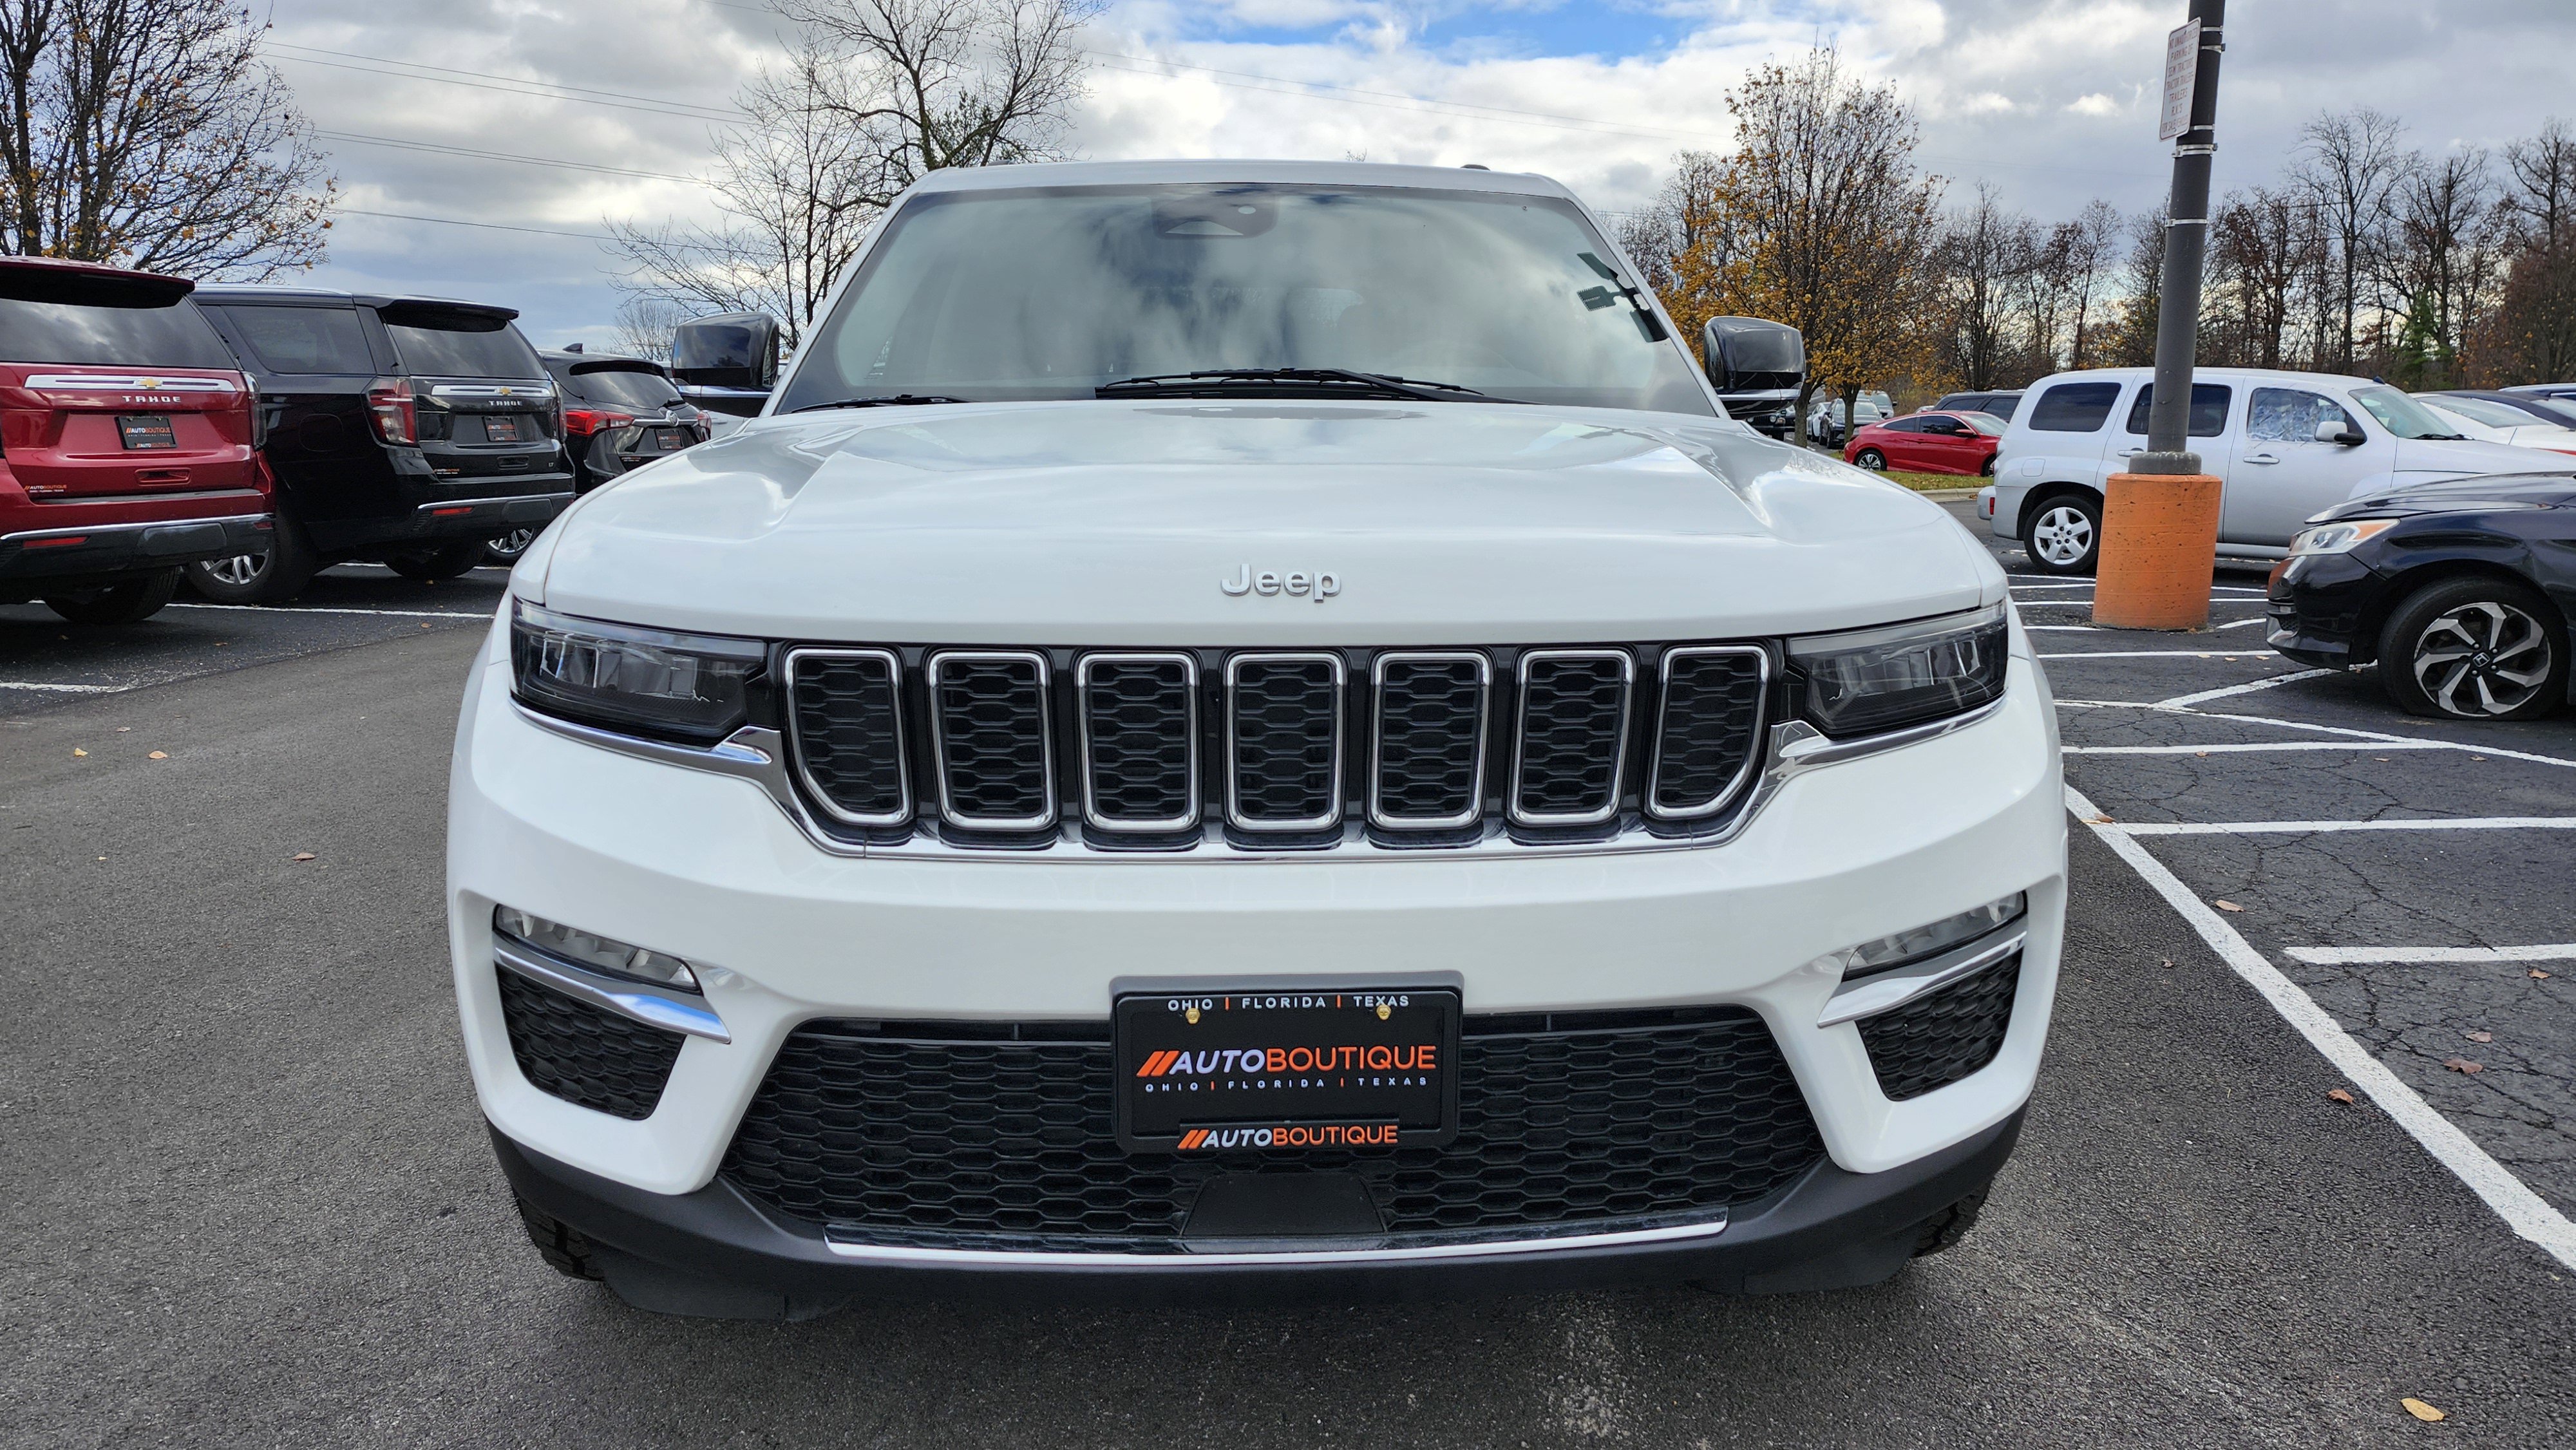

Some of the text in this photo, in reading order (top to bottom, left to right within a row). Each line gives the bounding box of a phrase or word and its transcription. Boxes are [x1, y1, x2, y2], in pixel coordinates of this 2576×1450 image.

[1220, 563, 1341, 603] Jeep
[1168, 995, 1410, 1012] OHIO FLORIDA TEXAS
[1168, 1044, 1437, 1076] AUTOBOUTIQUE
[1144, 1077, 1427, 1093] OHIO FLORIDA TEXAS
[1200, 1125, 1399, 1148] AUTOBOUTIQUE
